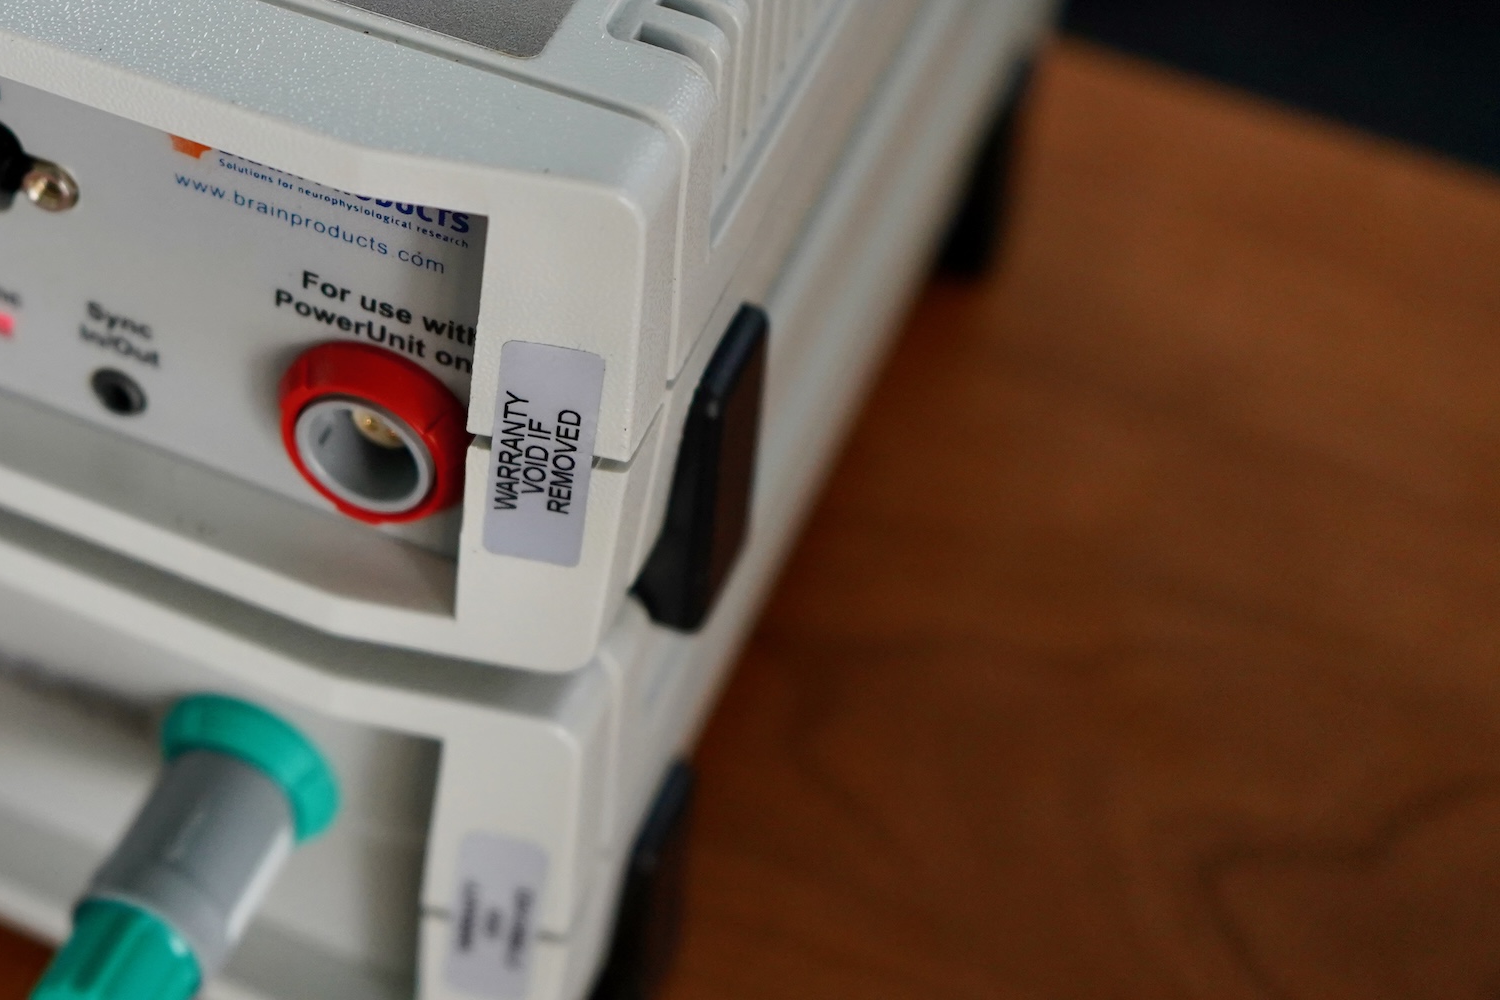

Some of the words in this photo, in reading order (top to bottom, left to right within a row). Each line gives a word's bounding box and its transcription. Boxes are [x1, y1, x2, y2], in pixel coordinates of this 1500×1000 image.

[174, 172, 445, 274] www.brainproducts.com
[217, 157, 274, 184] Solutions
[277, 177, 293, 190] for
[297, 187, 412, 231] neurophysiological
[416, 225, 470, 249] research
[86, 300, 153, 340] Sync
[274, 288, 426, 358] PowerUnit
[302, 270, 351, 302] For
[360, 294, 412, 324] use
[78, 322, 160, 367] In/Out
[493, 390, 529, 510] WARRANTY
[527, 418, 551, 440] IF
[521, 445, 549, 494] VOID
[546, 409, 581, 515] REMOVED
